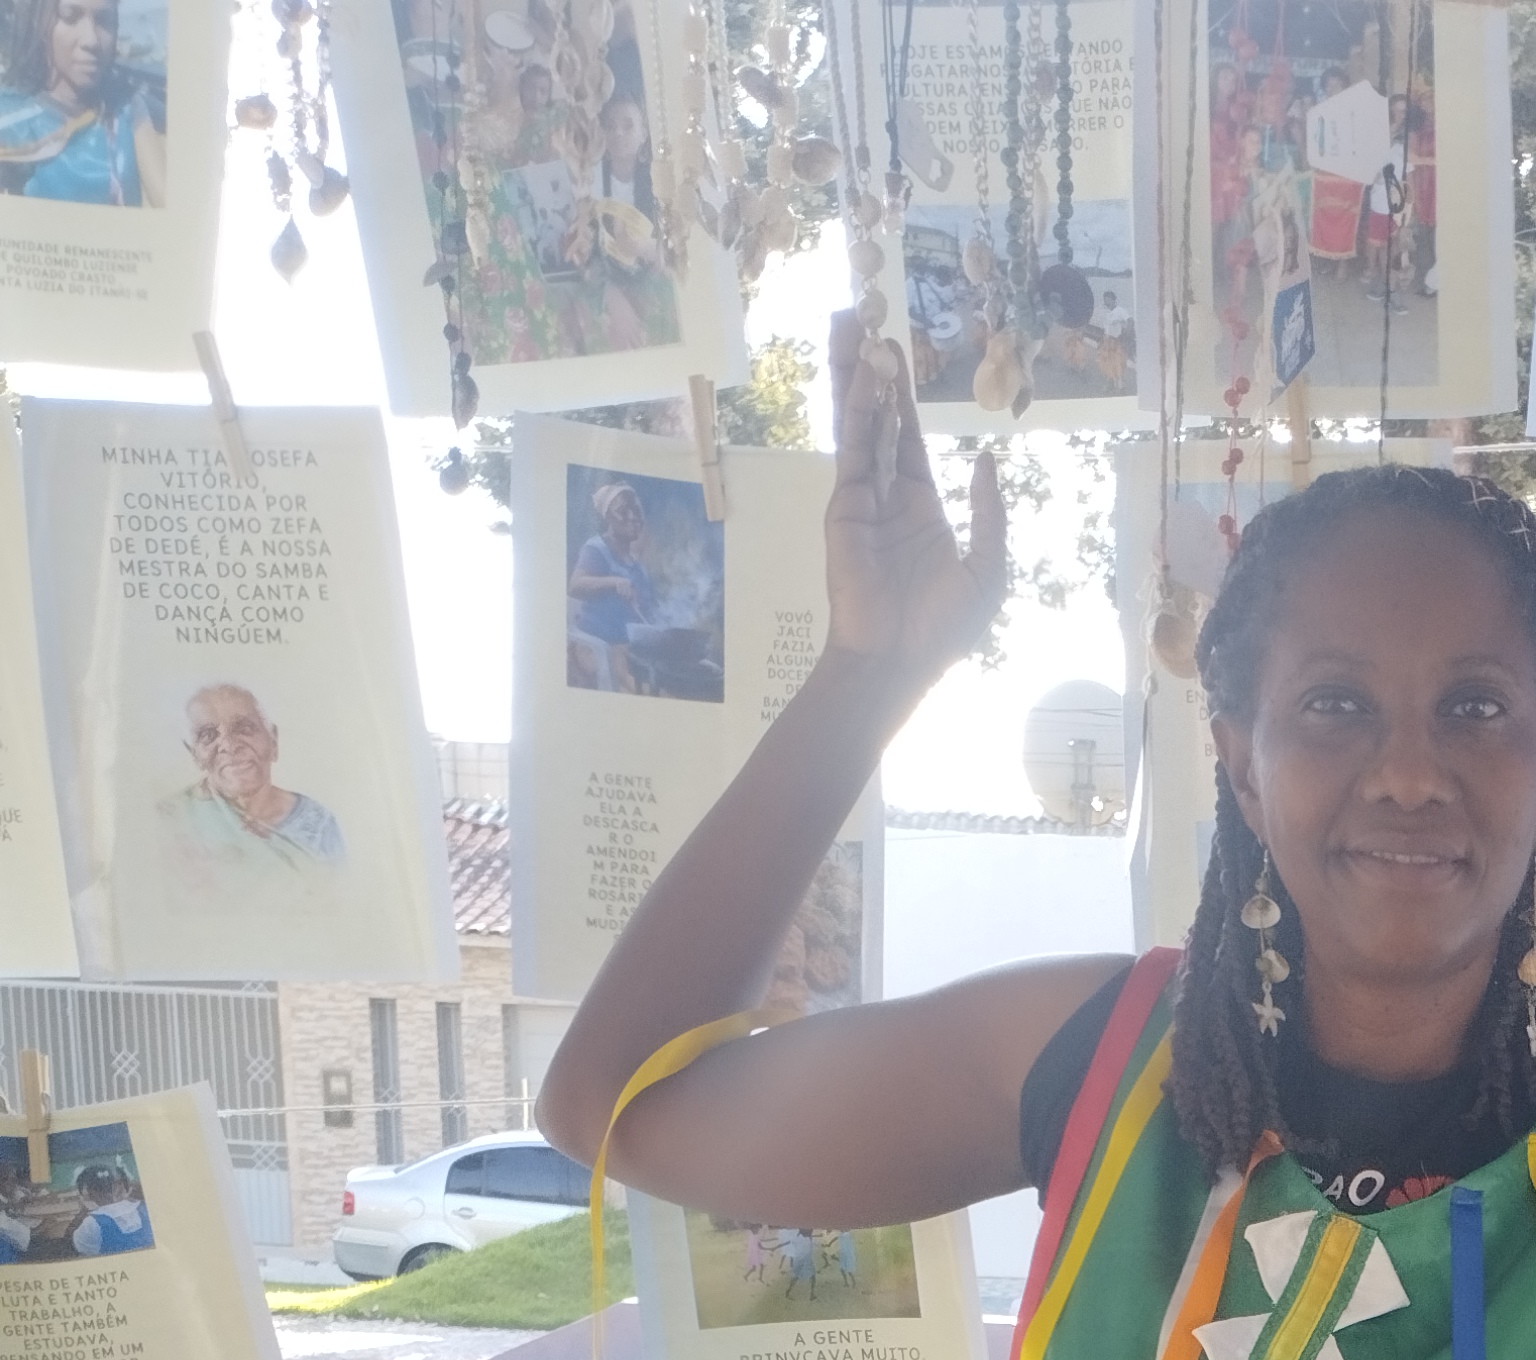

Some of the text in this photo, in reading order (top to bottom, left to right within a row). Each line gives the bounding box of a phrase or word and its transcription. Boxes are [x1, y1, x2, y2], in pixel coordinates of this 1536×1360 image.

[946, 42, 1025, 60] ESTAMS
[1089, 77, 1132, 93] PARA
[1098, 91, 1132, 110] NÃO
[1113, 114, 1125, 129] O
[13, 252, 80, 269] QUILOMBO
[6, 263, 67, 281] POVOADO
[26, 280, 65, 294] LUZIA
[101, 446, 319, 468] MINHA TIA OSEFA
[123, 492, 308, 513] CONHECIDA POR
[113, 514, 323, 535] TODOS COMO ZEFA
[109, 535, 333, 560] DE DEDÉ, É A NOSSA
[119, 559, 329, 580] MESTRA DO SAMBA
[123, 581, 330, 605] DE COCO, CANTA E
[155, 604, 305, 627] DANÇA COMO
[774, 610, 814, 624] VOVÓ
[777, 626, 811, 639] JACI
[773, 640, 816, 653] FAZIA
[589, 771, 653, 790] A GENTE
[585, 785, 658, 804] AJUDAVA
[600, 801, 643, 818] ELA A
[582, 814, 661, 834] DESCASCA
[608, 831, 635, 846] R O
[585, 844, 658, 863] AMENDOI
[593, 859, 651, 877] M PARA
[589, 873, 637, 889] FAZER
[606, 903, 615, 917] E
[49, 1277, 70, 1291] DE
[74, 1270, 130, 1288] TANTA
[1, 1286, 118, 1308] LUTA E TANTO
[9, 1301, 117, 1322] TRABALHO, A
[3, 1314, 128, 1337] GENTE TAMBÉM
[23, 1332, 114, 1351] ESTUDAVA,
[793, 1329, 875, 1347] A GENTE
[92, 1346, 115, 1360] EM
[120, 1342, 144, 1356] UM
